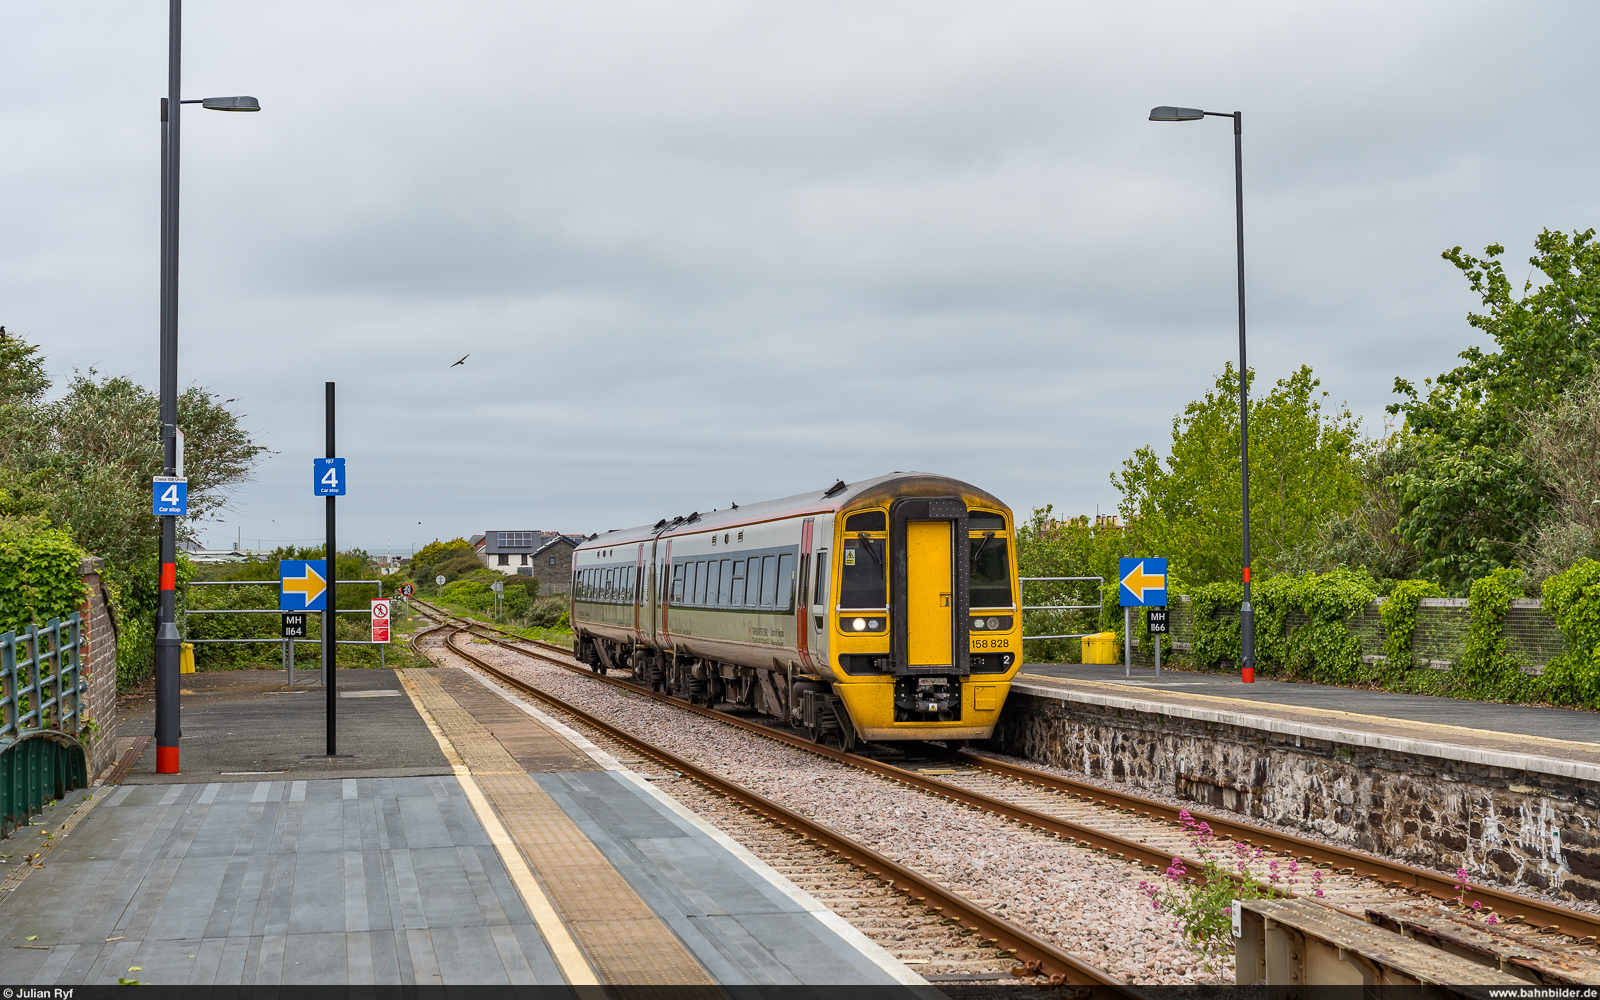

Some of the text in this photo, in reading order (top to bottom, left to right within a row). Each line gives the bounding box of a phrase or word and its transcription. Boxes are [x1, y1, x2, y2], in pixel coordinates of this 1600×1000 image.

[321, 467, 338, 487] 4
[161, 484, 179, 505] 4
[286, 615, 302, 624] MH
[1151, 612, 1165, 621] MH
[285, 627, 302, 636] 1164
[972, 638, 1009, 649] 158 828
[1003, 655, 1010, 665] 2
